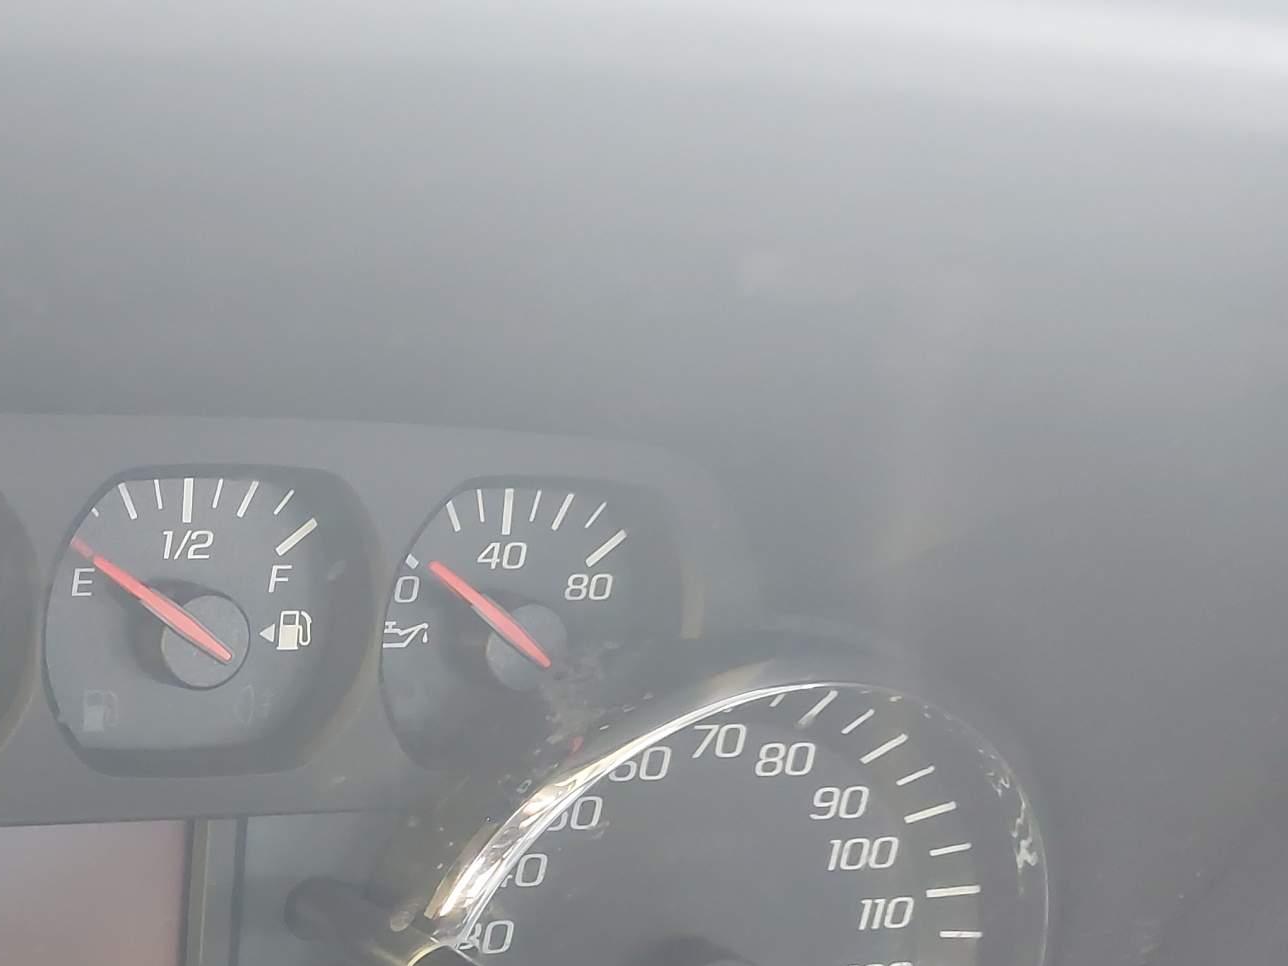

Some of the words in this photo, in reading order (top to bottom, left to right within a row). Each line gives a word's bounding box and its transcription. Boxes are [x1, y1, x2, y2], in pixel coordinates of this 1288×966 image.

[162, 530, 214, 560] 1/2
[477, 542, 528, 570] 40
[71, 568, 95, 596] E
[268, 565, 292, 593] F
[394, 576, 420, 603] 0
[564, 574, 613, 601] 80
[692, 724, 747, 759] 70
[755, 742, 816, 777] 80
[809, 786, 869, 820] 90
[827, 837, 899, 871] 100
[858, 897, 914, 930] 110
